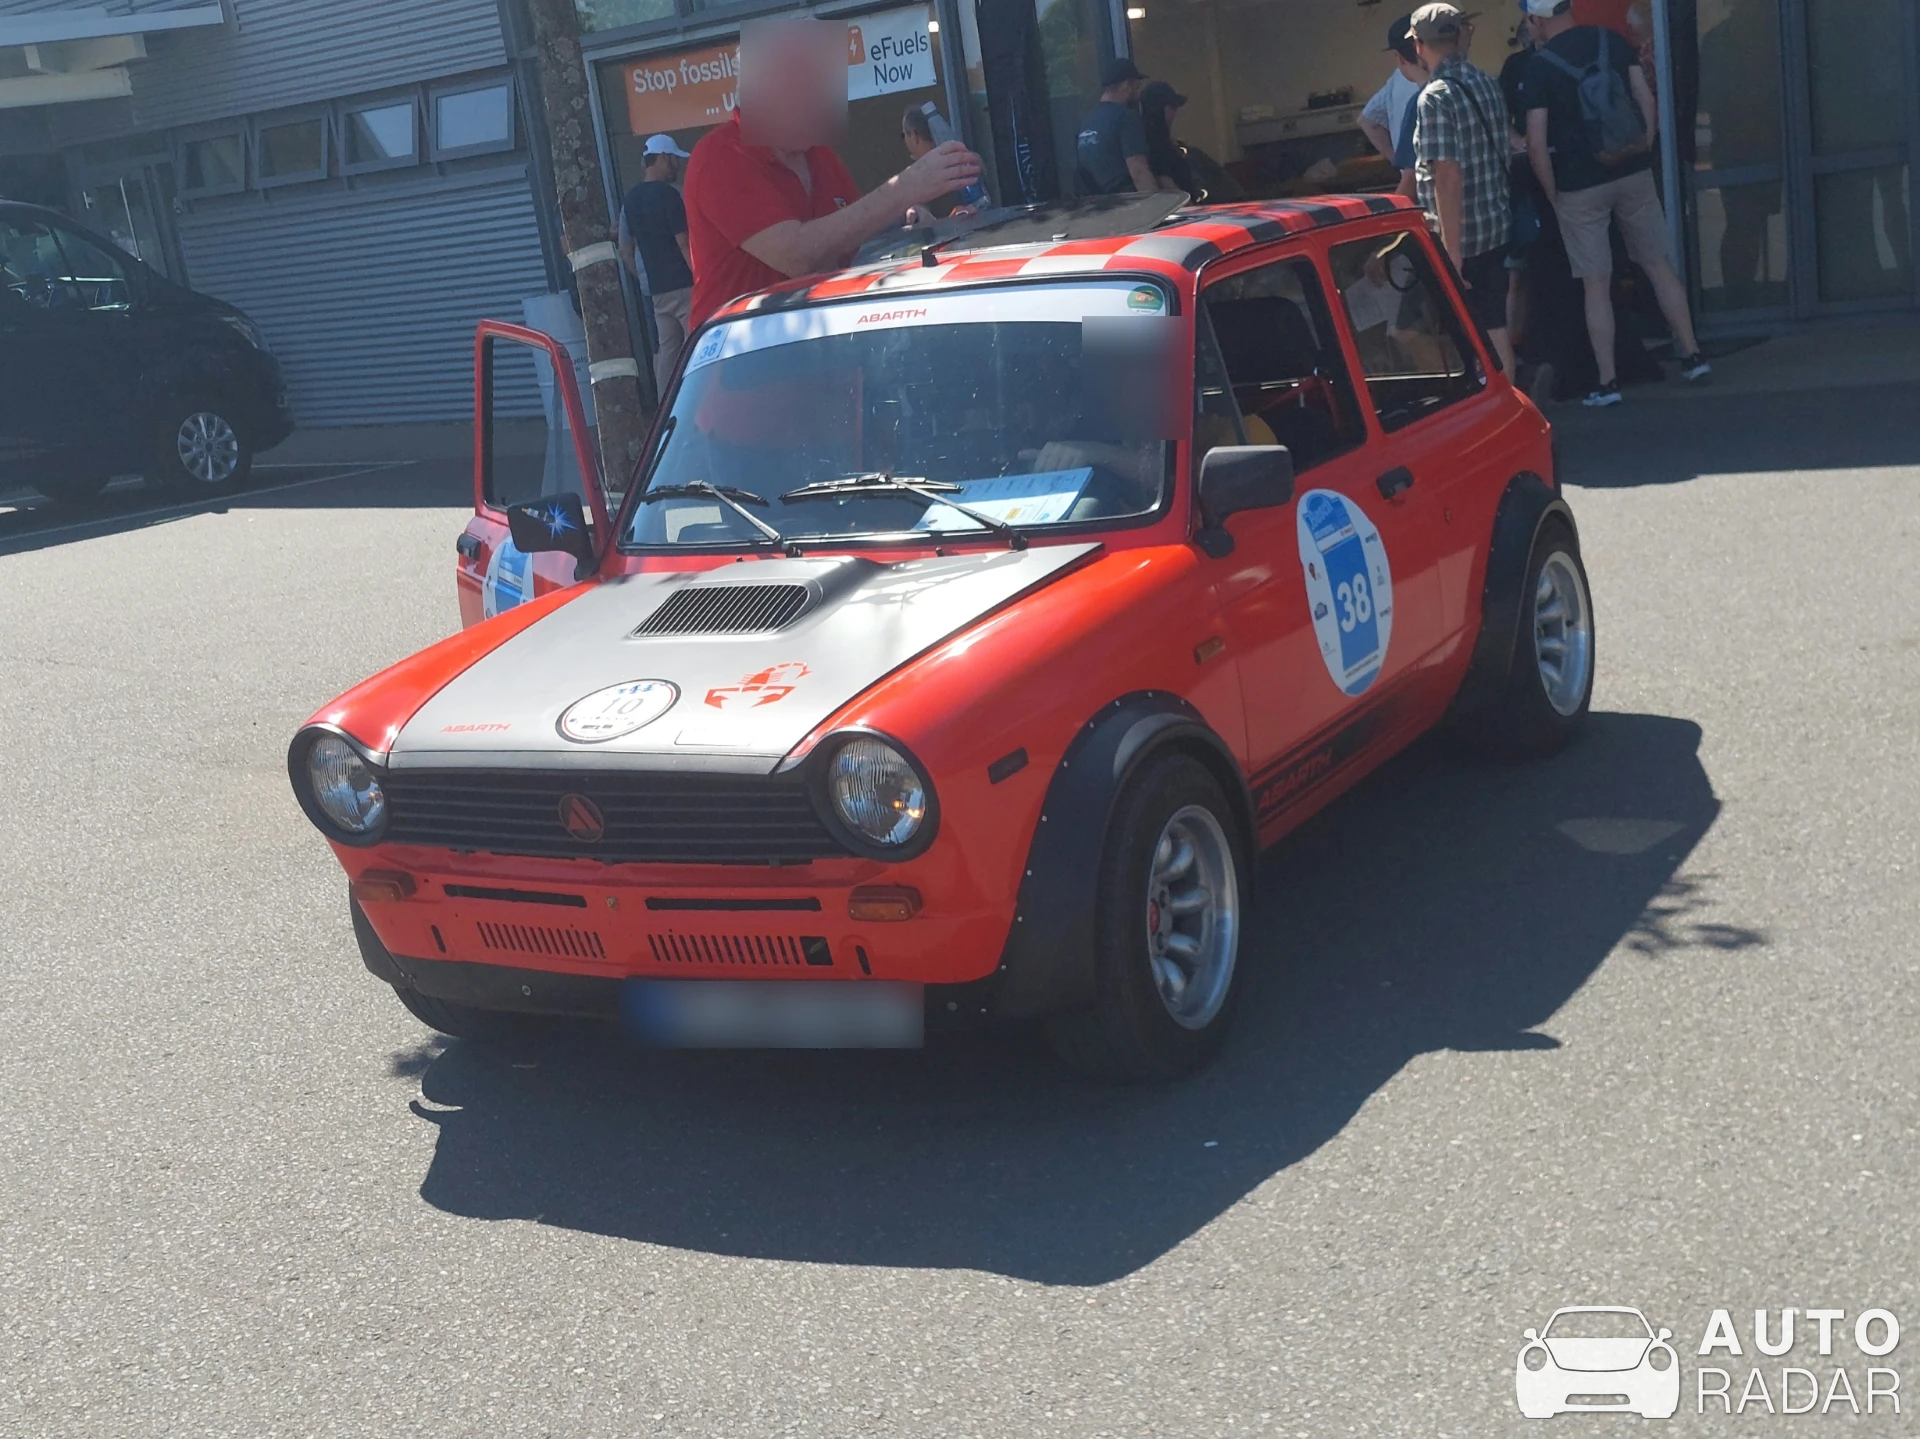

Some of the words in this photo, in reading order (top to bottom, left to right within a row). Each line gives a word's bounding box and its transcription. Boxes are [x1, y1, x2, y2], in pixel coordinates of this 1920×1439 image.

[870, 31, 928, 61] eFuels
[633, 68, 677, 94] Stop
[679, 52, 741, 85] fossils
[873, 63, 913, 86] Now
[857, 308, 927, 325] ABARTH
[700, 342, 718, 360] 38
[1336, 573, 1371, 633] 38
[440, 723, 511, 733] ABARTH
